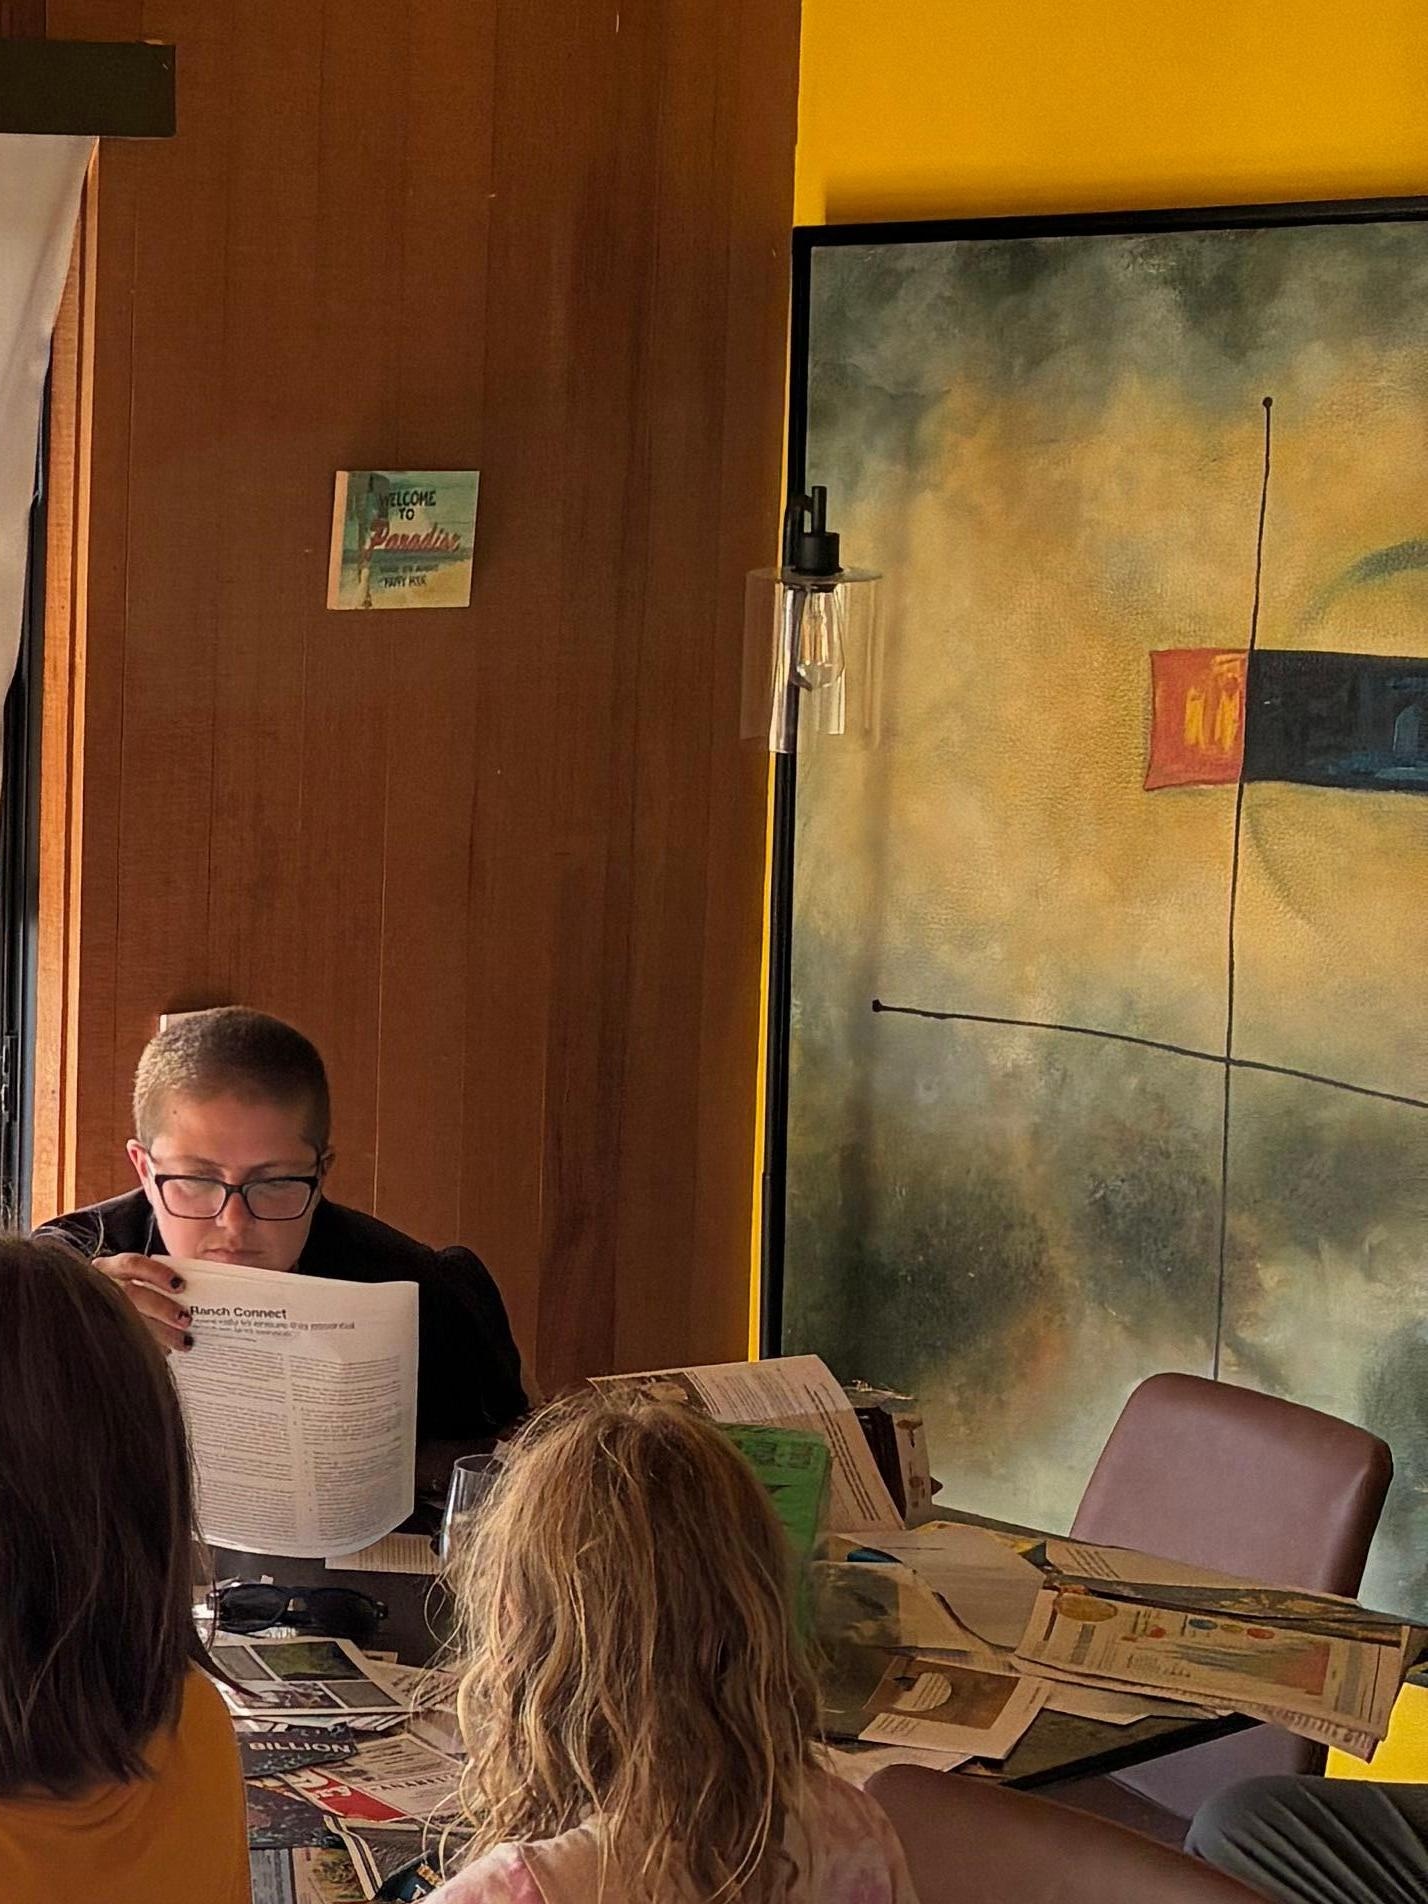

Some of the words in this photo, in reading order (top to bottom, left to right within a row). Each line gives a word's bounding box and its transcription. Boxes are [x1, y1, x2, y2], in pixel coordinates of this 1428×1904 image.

[380, 490, 436, 507] WELCOME
[398, 507, 415, 521] TO
[190, 1305, 231, 1317] Ranch
[233, 1306, 287, 1320] Connect
[249, 1741, 352, 1754] BILLION
